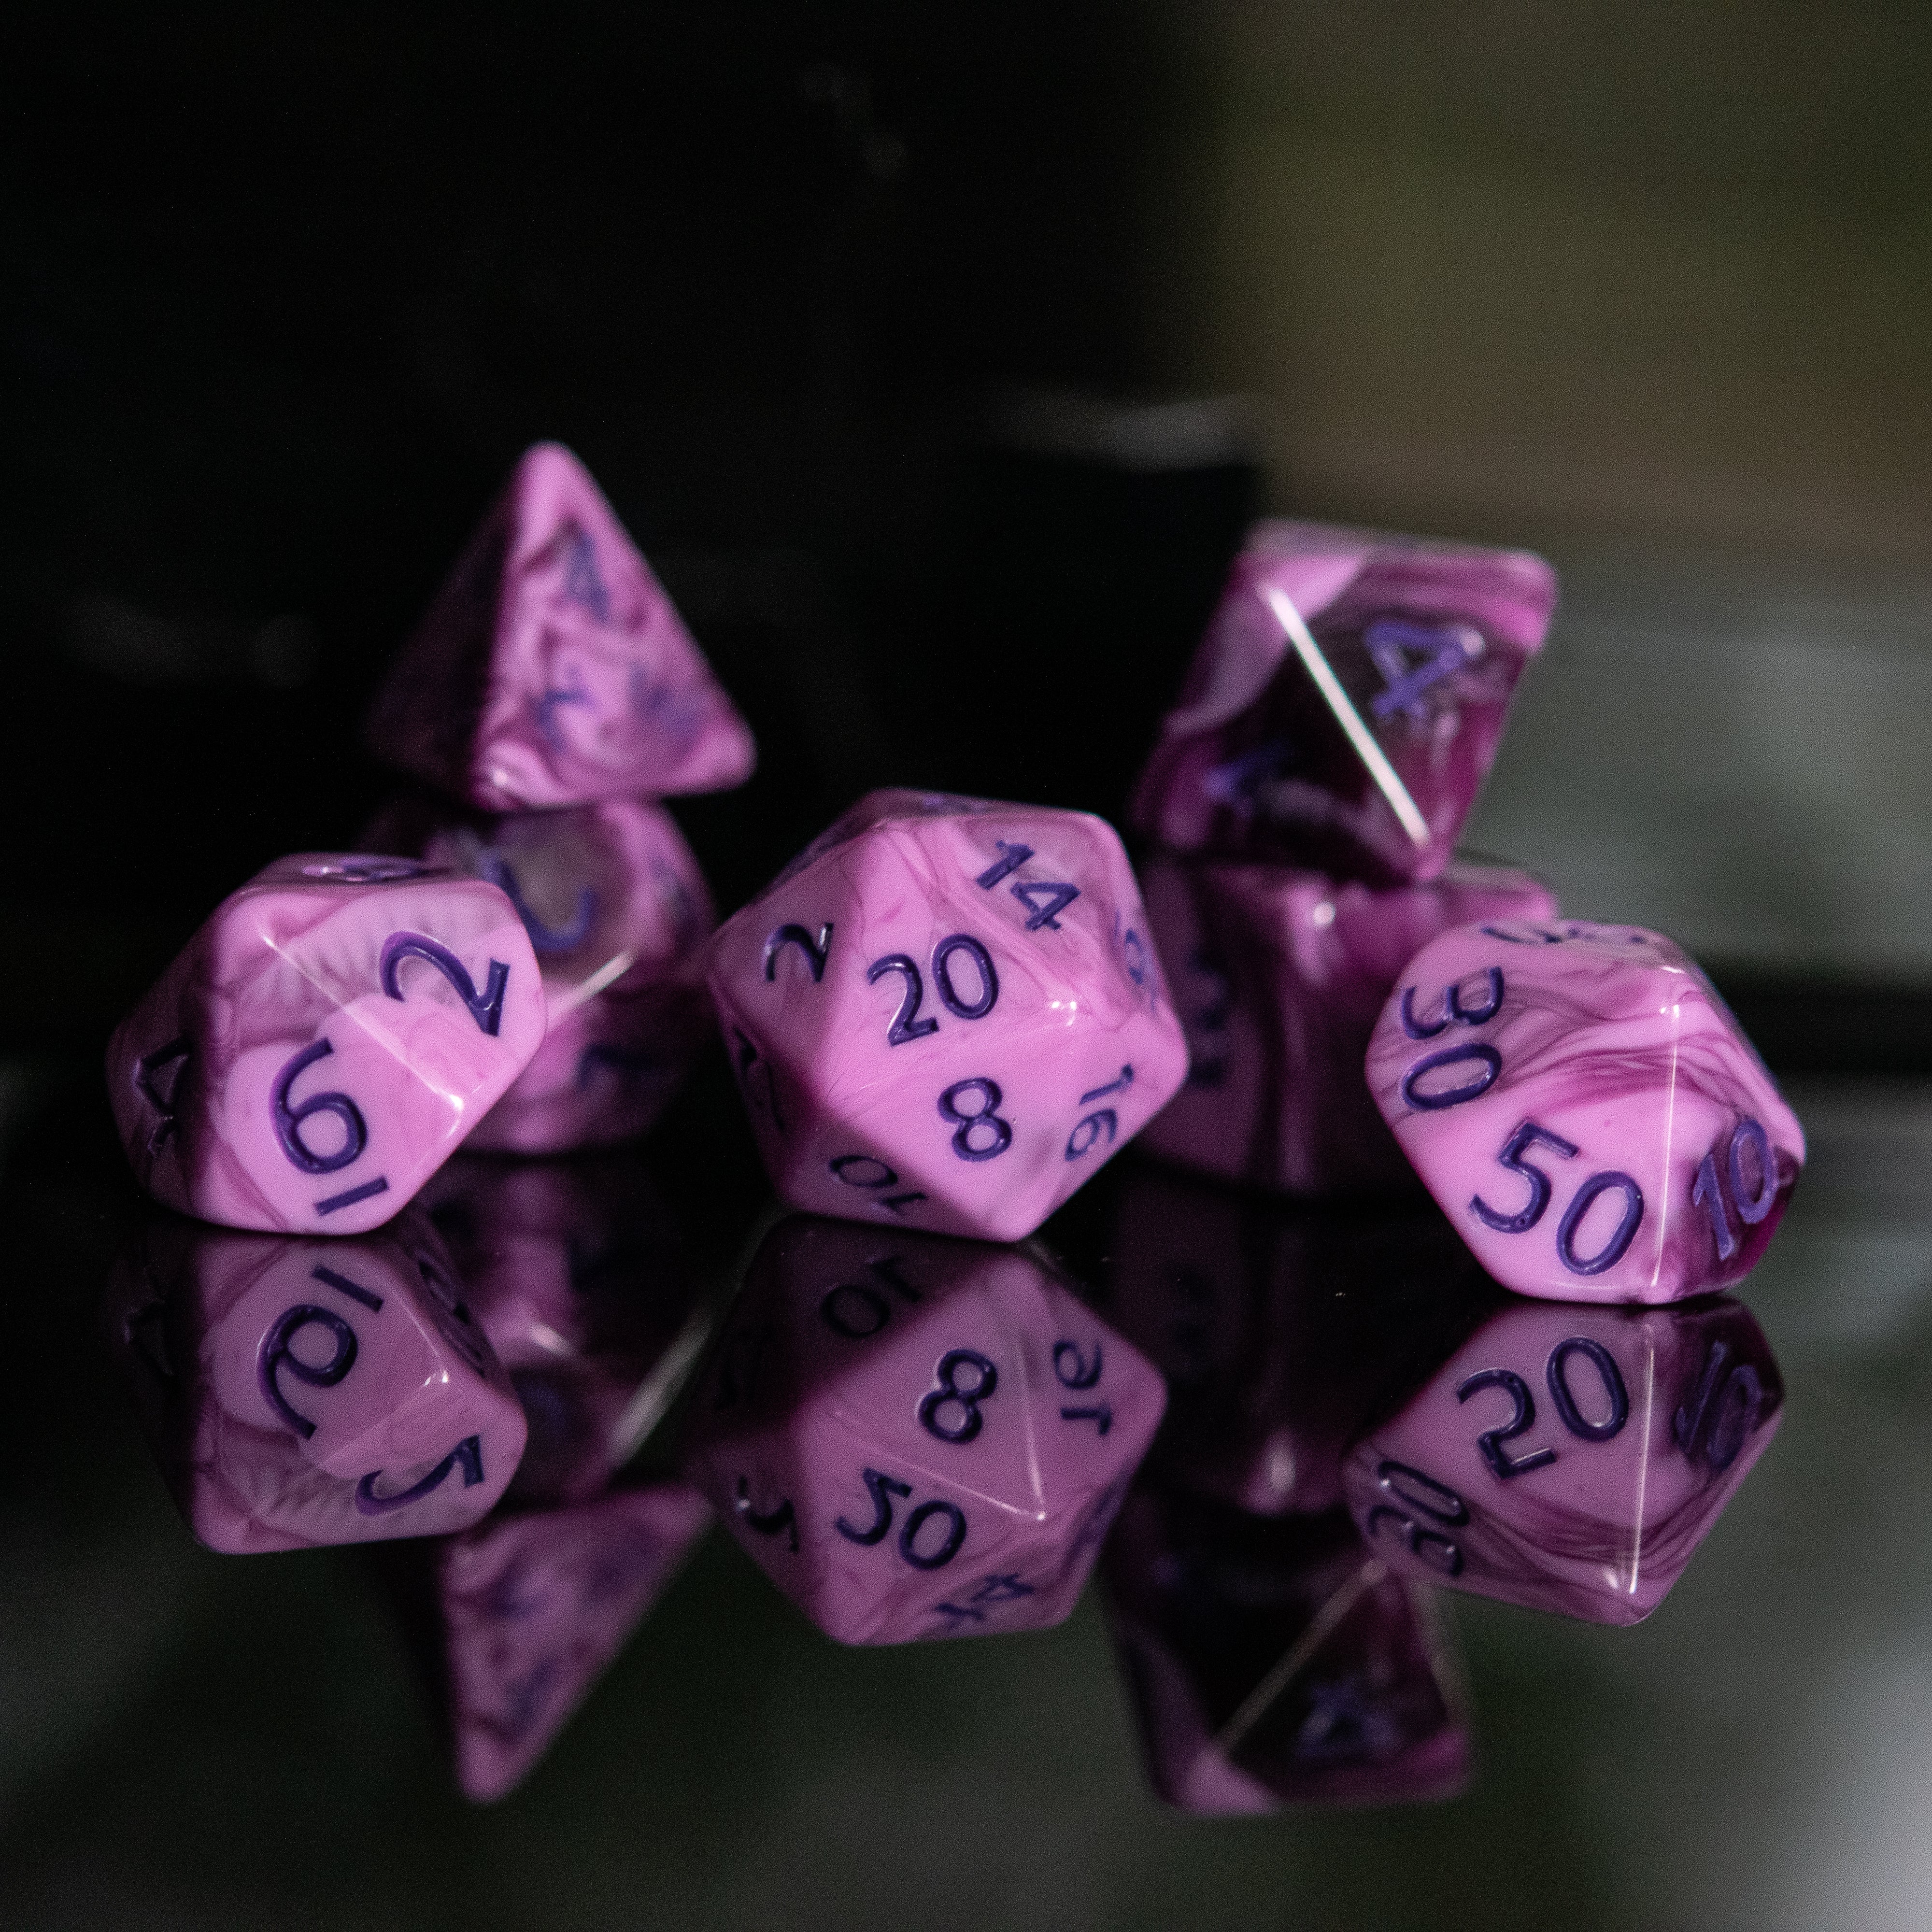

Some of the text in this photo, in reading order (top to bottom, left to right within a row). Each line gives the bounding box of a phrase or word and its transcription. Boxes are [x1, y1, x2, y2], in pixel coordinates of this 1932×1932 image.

[977, 839, 1081, 931] 14
[380, 930, 511, 1037] 2
[764, 922, 835, 983] 2
[867, 934, 1000, 1047] 20
[1401, 966, 1505, 1111] 30
[937, 1077, 1013, 1162] 8
[1064, 1064, 1135, 1161] 16
[829, 1154, 927, 1211] 10
[1468, 1122, 1646, 1276] 50
[1693, 1119, 1780, 1261] 10
